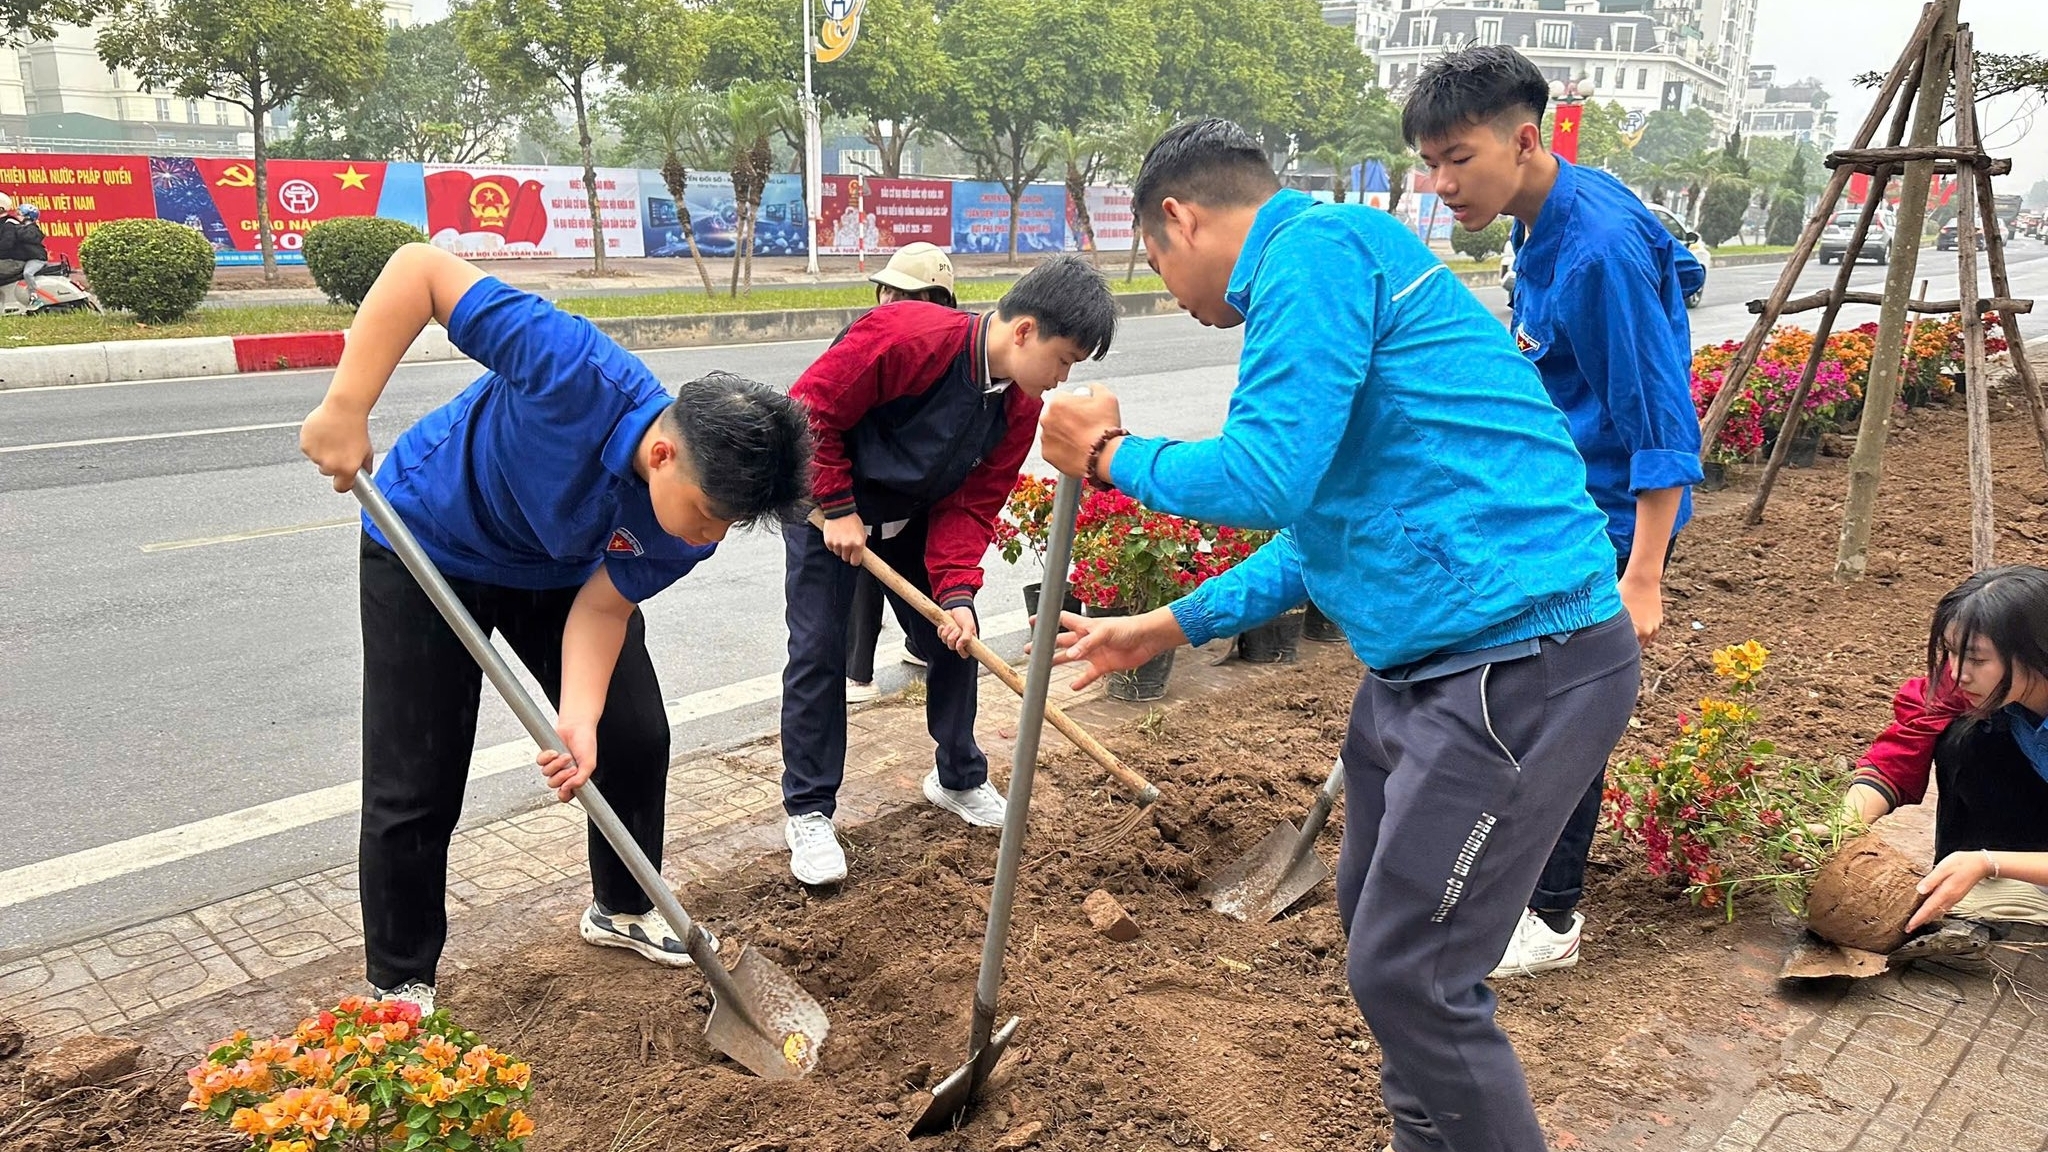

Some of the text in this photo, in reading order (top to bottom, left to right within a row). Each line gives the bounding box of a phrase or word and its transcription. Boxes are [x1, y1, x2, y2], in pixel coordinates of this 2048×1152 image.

[27, 166, 48, 184] NHÀ
[49, 166, 75, 184] NƯỚC
[76, 166, 101, 184] PHÁP
[22, 193, 51, 210] NGHĨA
[52, 193, 71, 213] VIỆT
[73, 196, 95, 210] NAM
[50, 219, 73, 238] DÂN,
[74, 219, 85, 236] VÌ
[1453, 812, 1497, 877] PREMIUM
